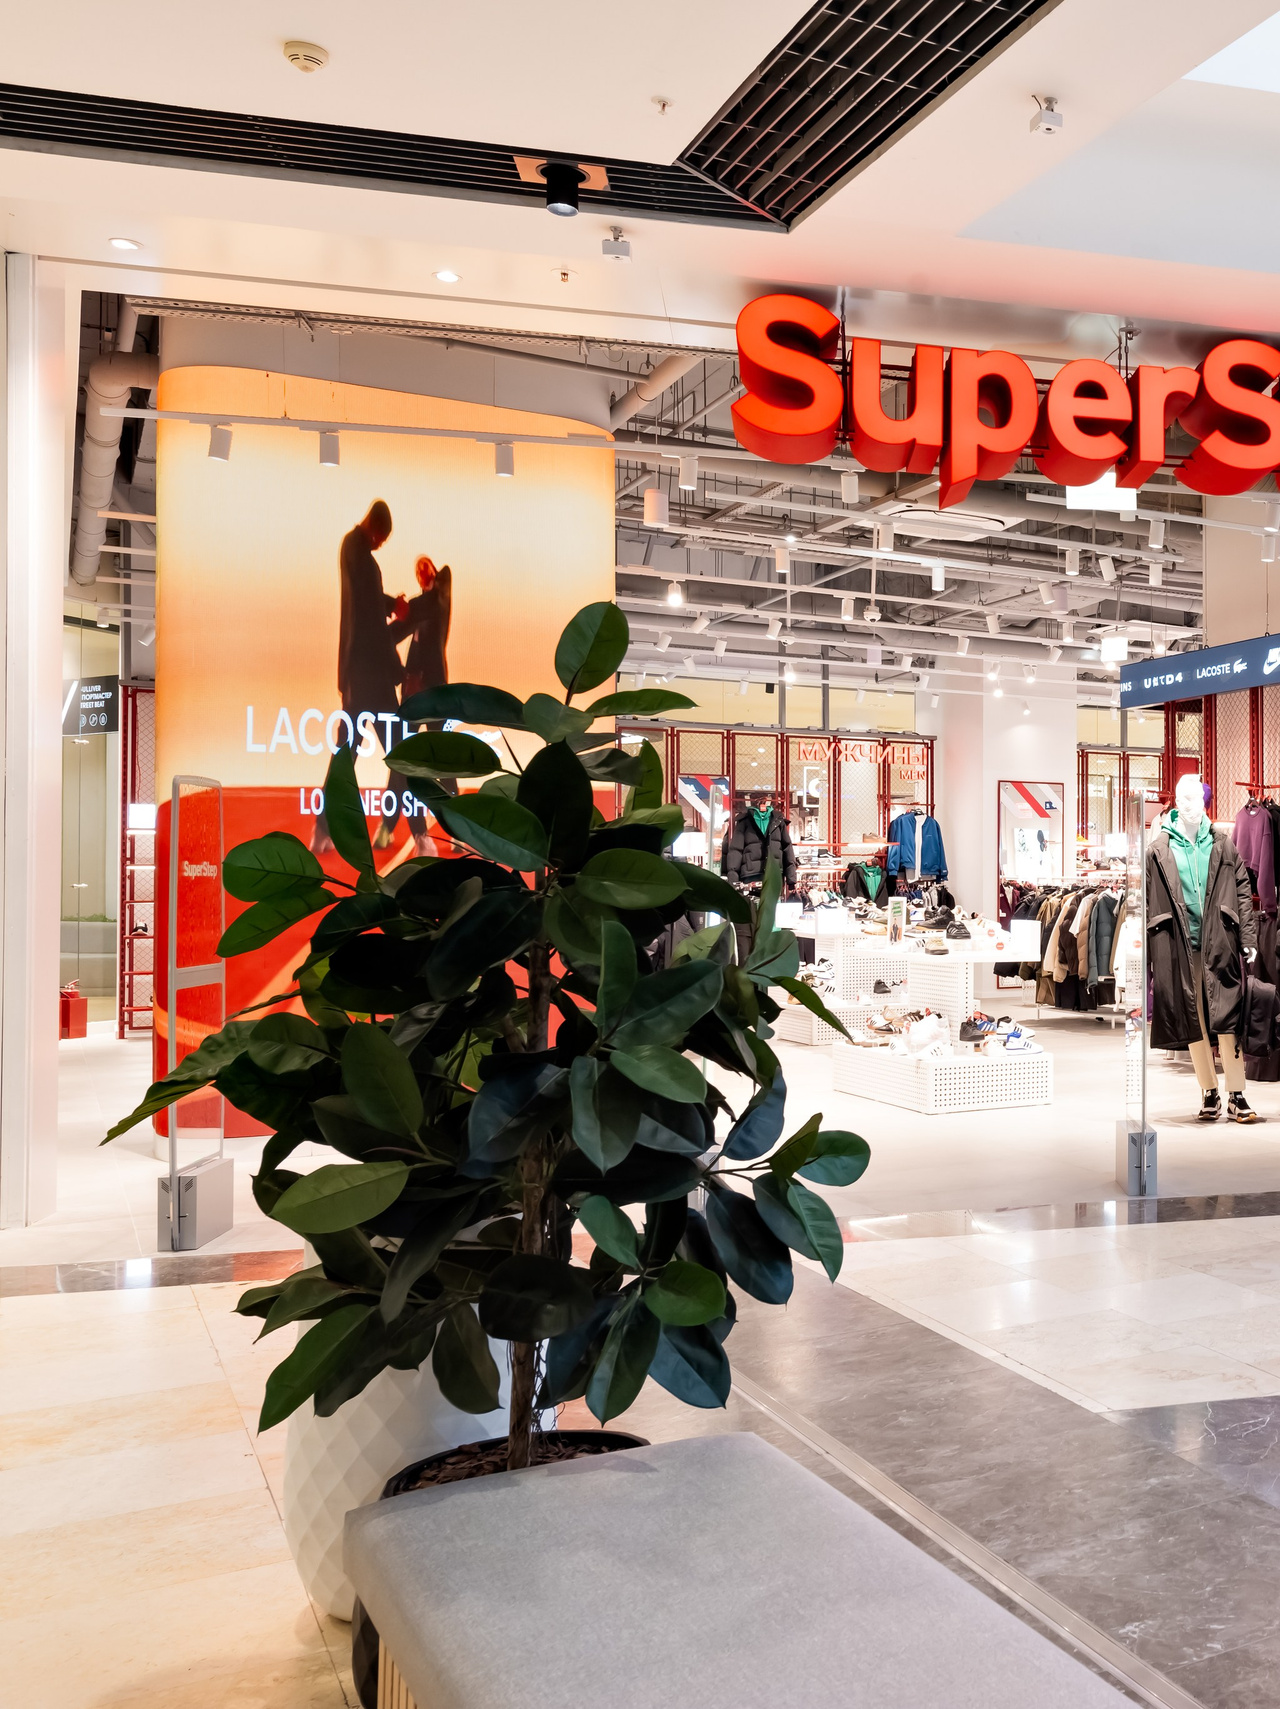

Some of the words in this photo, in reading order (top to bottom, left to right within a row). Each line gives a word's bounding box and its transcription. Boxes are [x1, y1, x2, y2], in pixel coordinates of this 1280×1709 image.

[1196, 663, 1231, 679] LACOSTE
[798, 740, 928, 766] МУЖЧИНЫ
[899, 768, 927, 781] MEN
[183, 860, 218, 880] SuperStep
